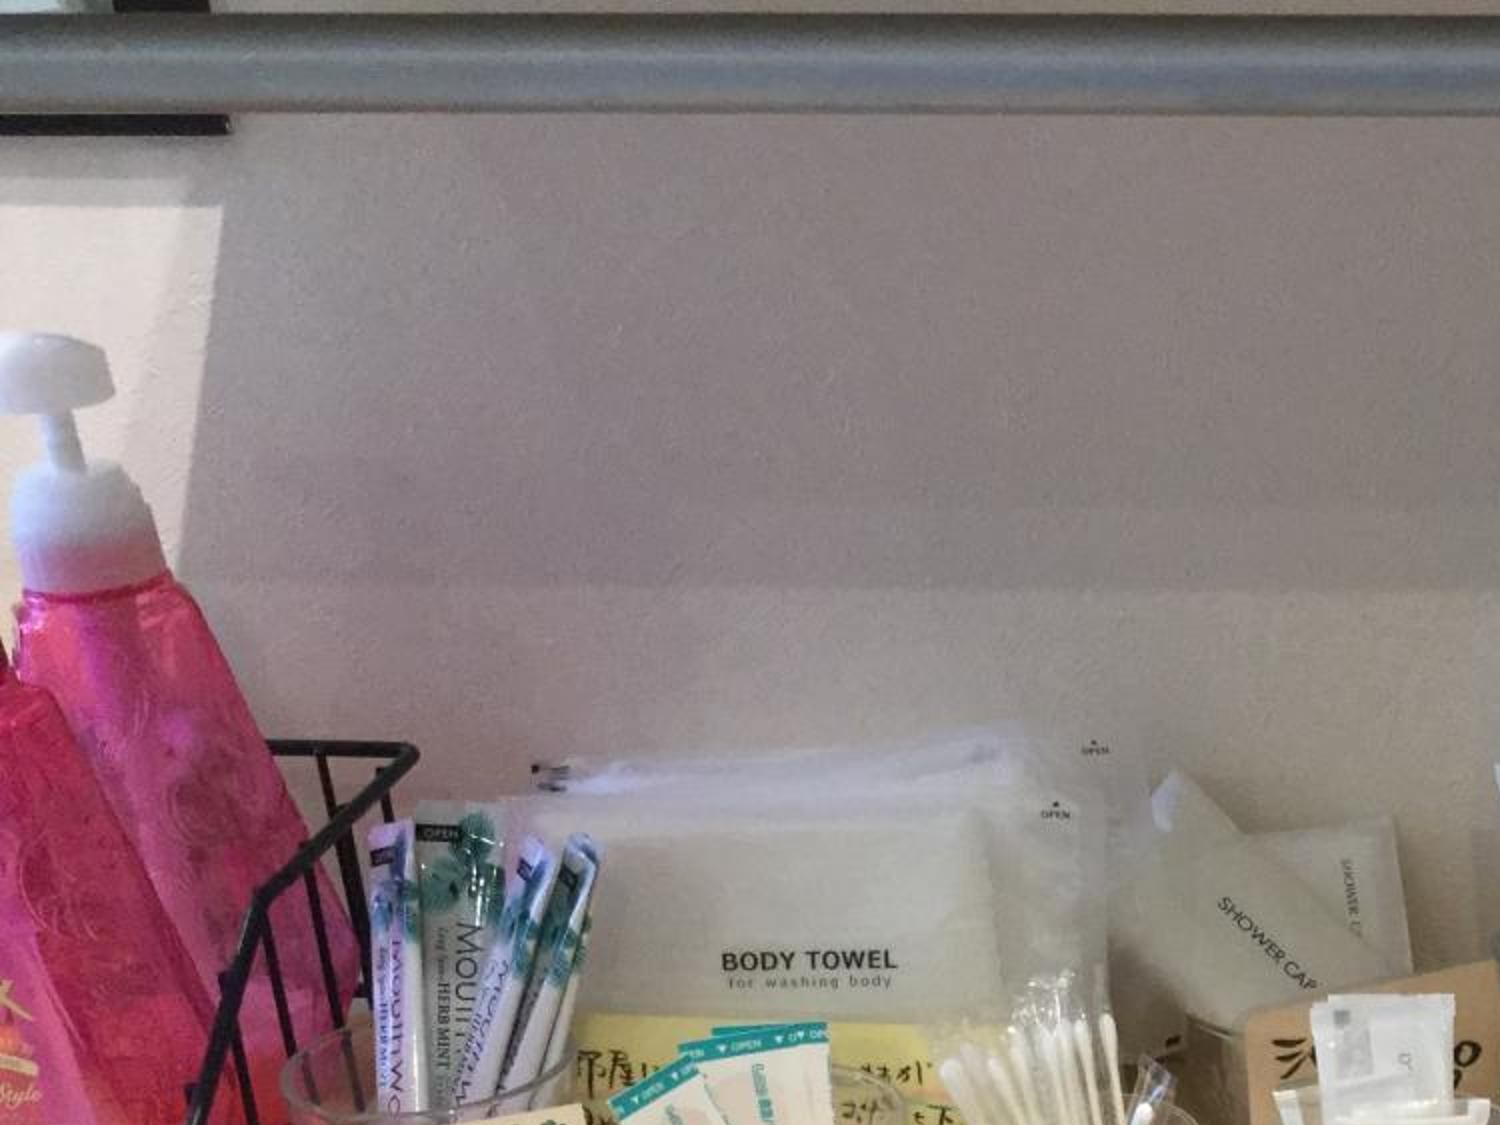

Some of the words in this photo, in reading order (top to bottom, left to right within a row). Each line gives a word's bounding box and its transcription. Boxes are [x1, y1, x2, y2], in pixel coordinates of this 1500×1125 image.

[1217, 896, 1287, 967] SHOWER
[1281, 959, 1319, 992] CAP
[720, 950, 796, 973] BODY
[804, 948, 898, 972] TOWEL
[727, 976, 754, 991] for
[763, 976, 839, 994] washing
[848, 974, 893, 992] body
